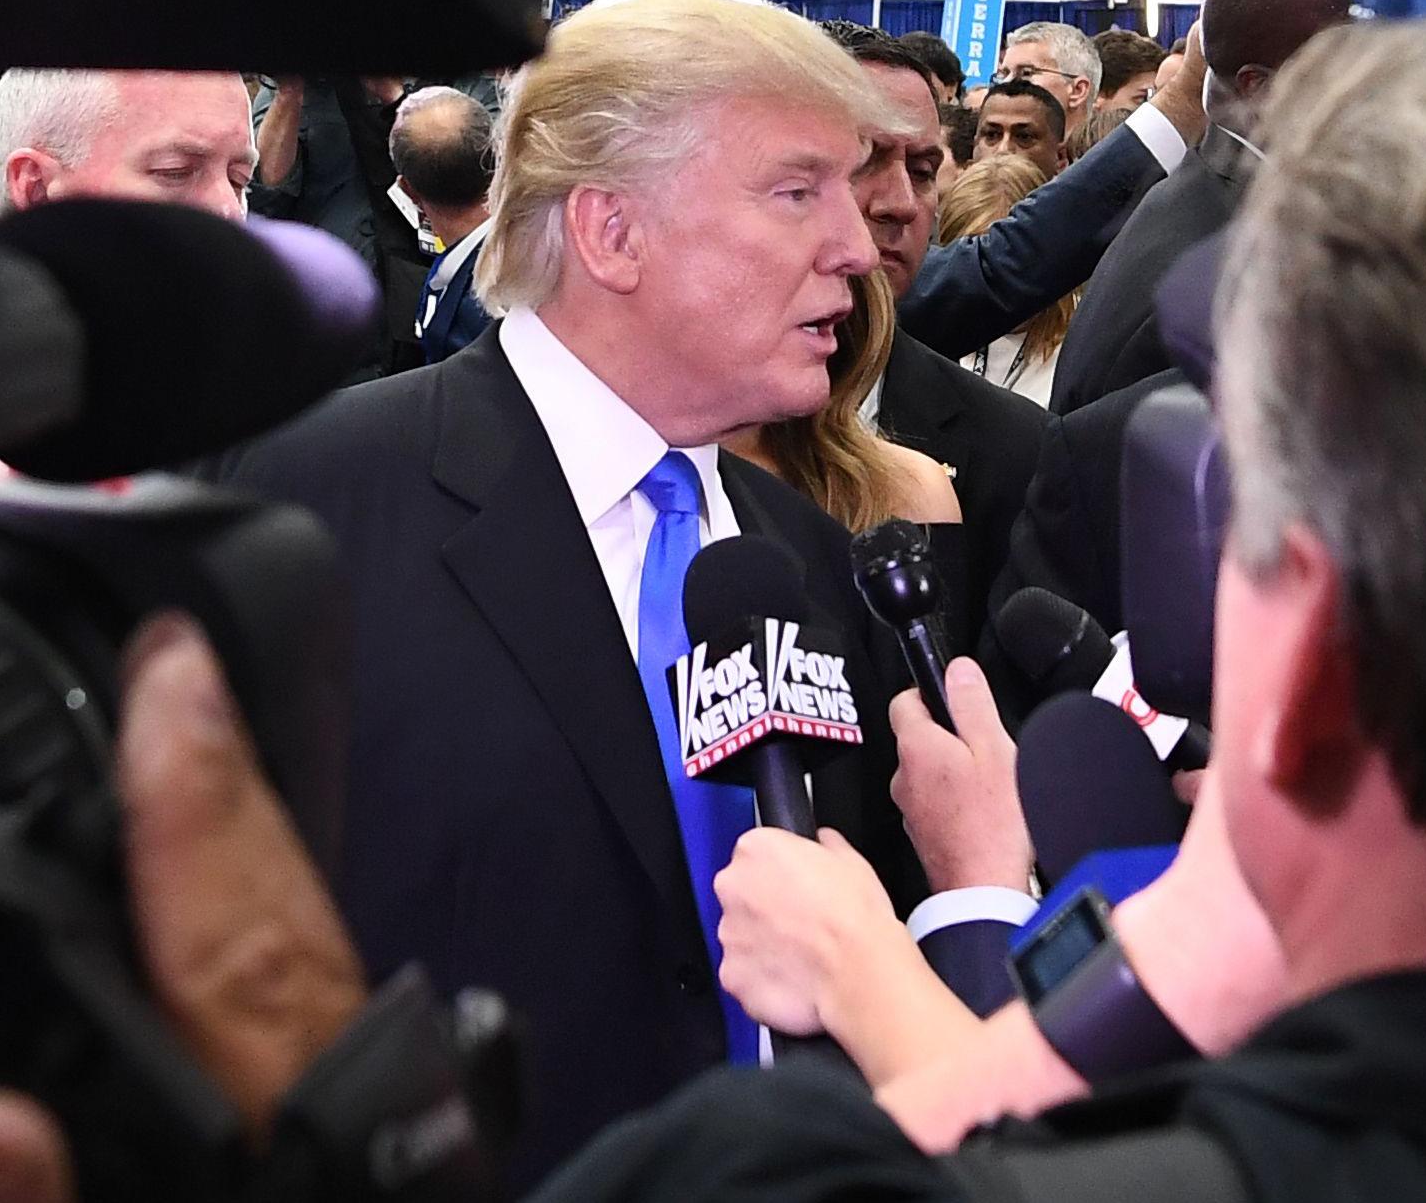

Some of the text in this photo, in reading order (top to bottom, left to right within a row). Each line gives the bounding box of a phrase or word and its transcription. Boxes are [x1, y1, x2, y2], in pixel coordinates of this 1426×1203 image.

[699, 643, 760, 709] FOX
[788, 648, 851, 691] FOX
[690, 681, 766, 752] NEWS
[778, 679, 858, 724] NEWS
[686, 715, 772, 777] channel
[774, 717, 864, 745] channel
